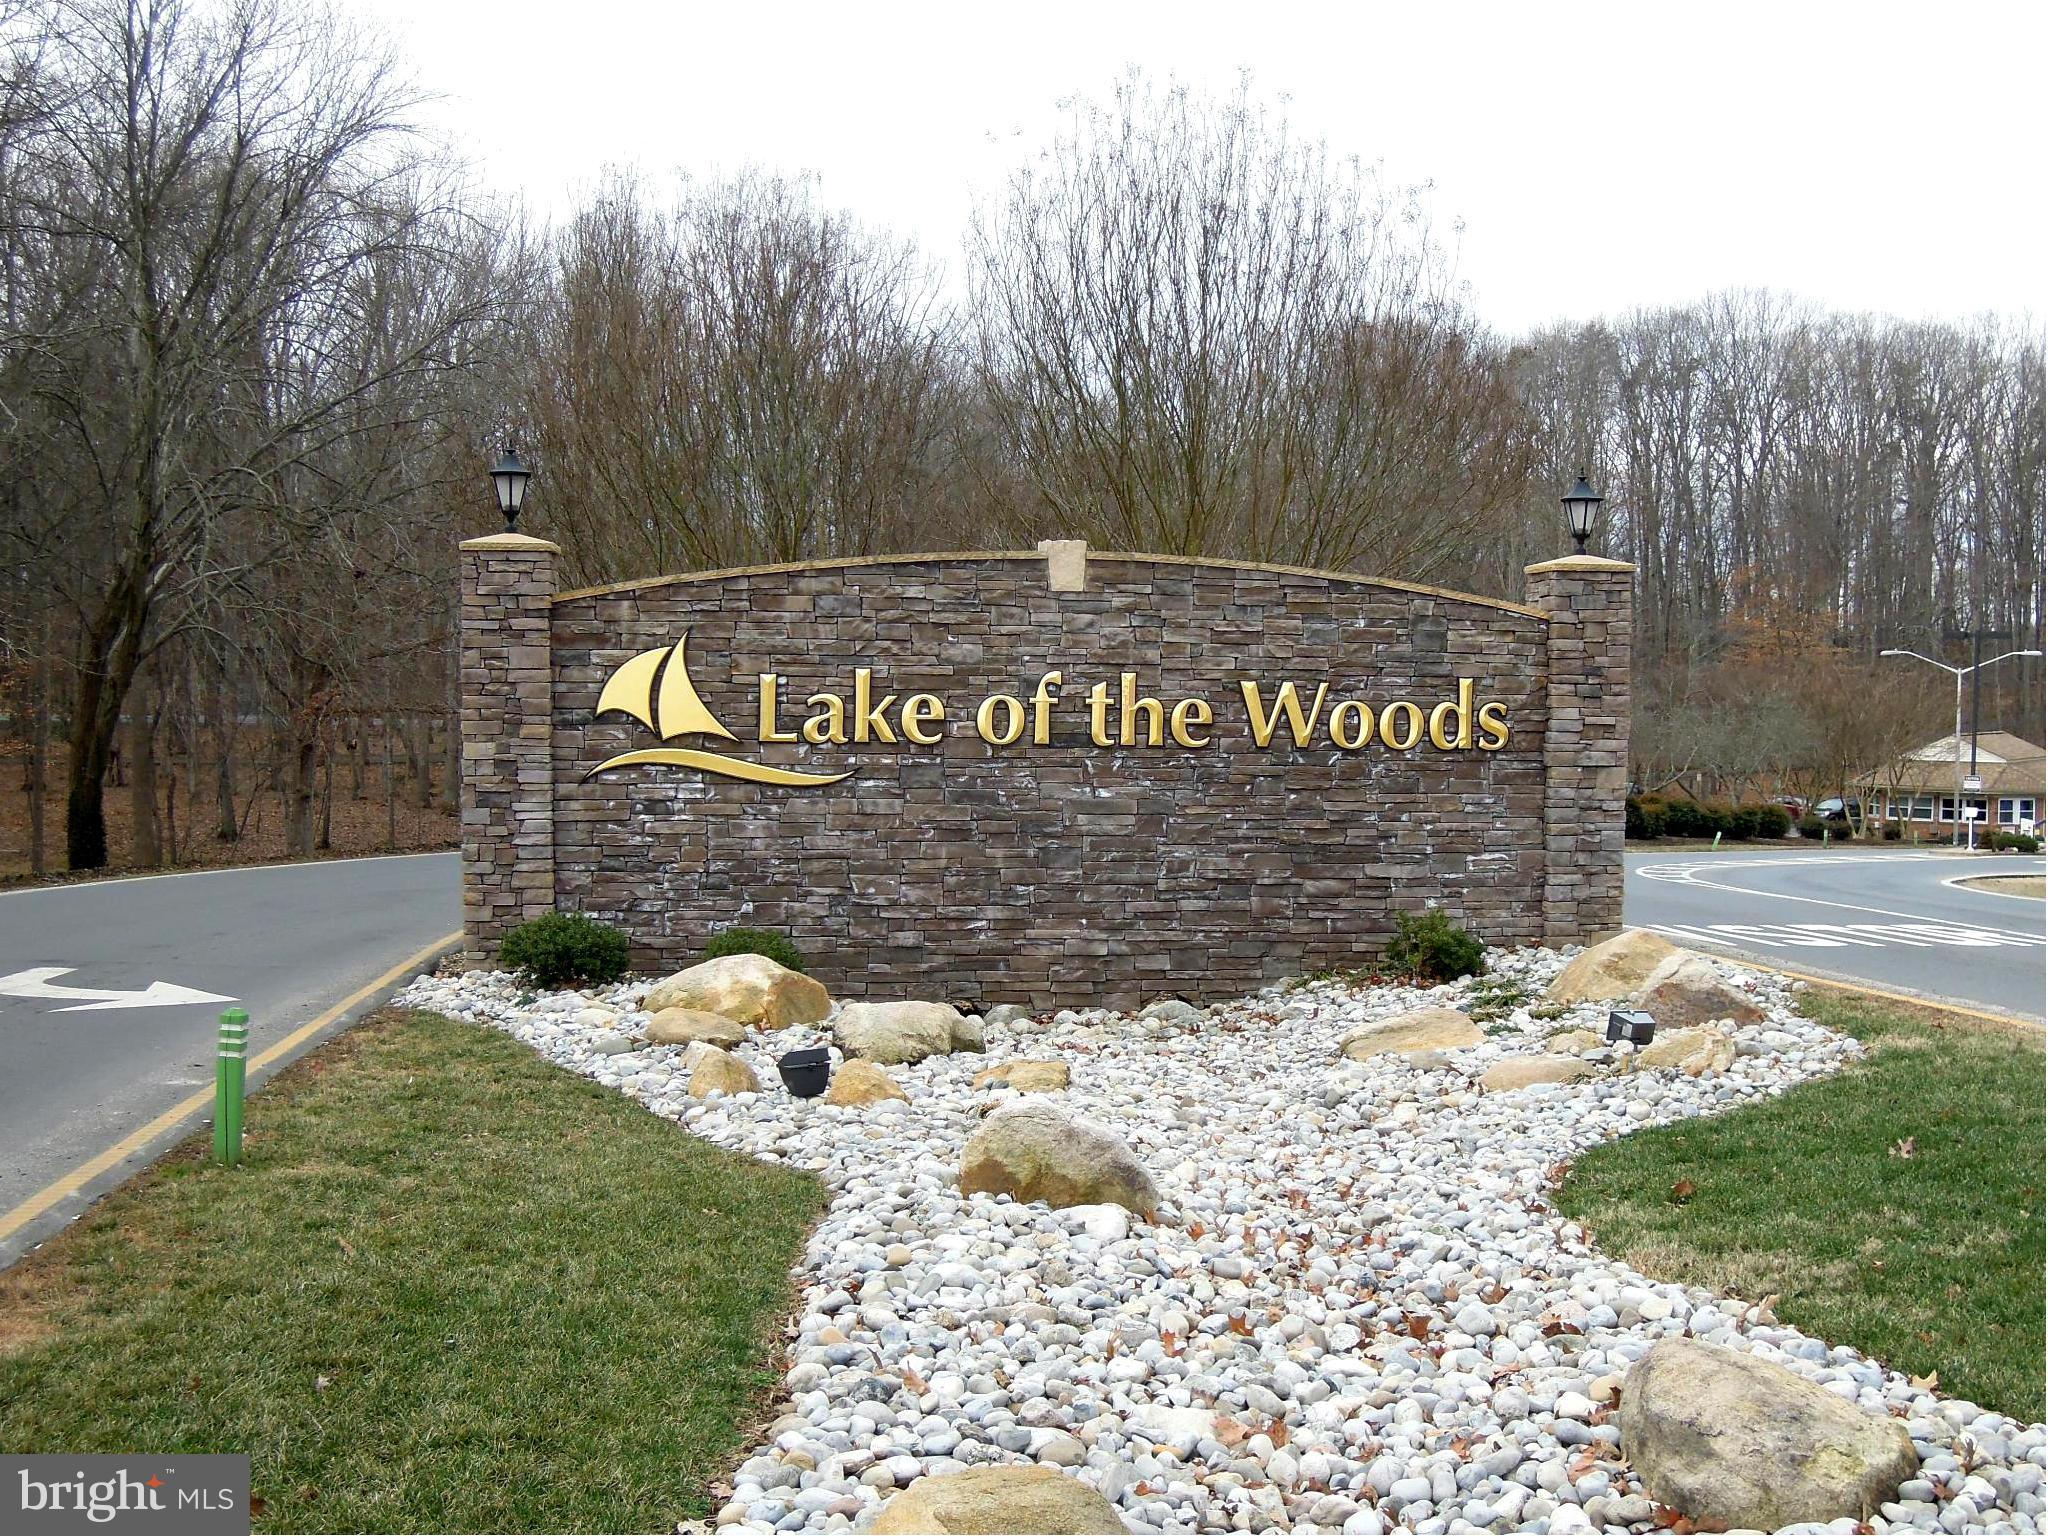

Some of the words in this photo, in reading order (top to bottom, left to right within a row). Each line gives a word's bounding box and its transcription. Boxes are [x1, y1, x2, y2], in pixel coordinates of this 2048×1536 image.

[758, 667, 946, 745] Lake
[976, 670, 1063, 746] of
[1085, 672, 1214, 748] the
[1240, 677, 1510, 751] Woods
